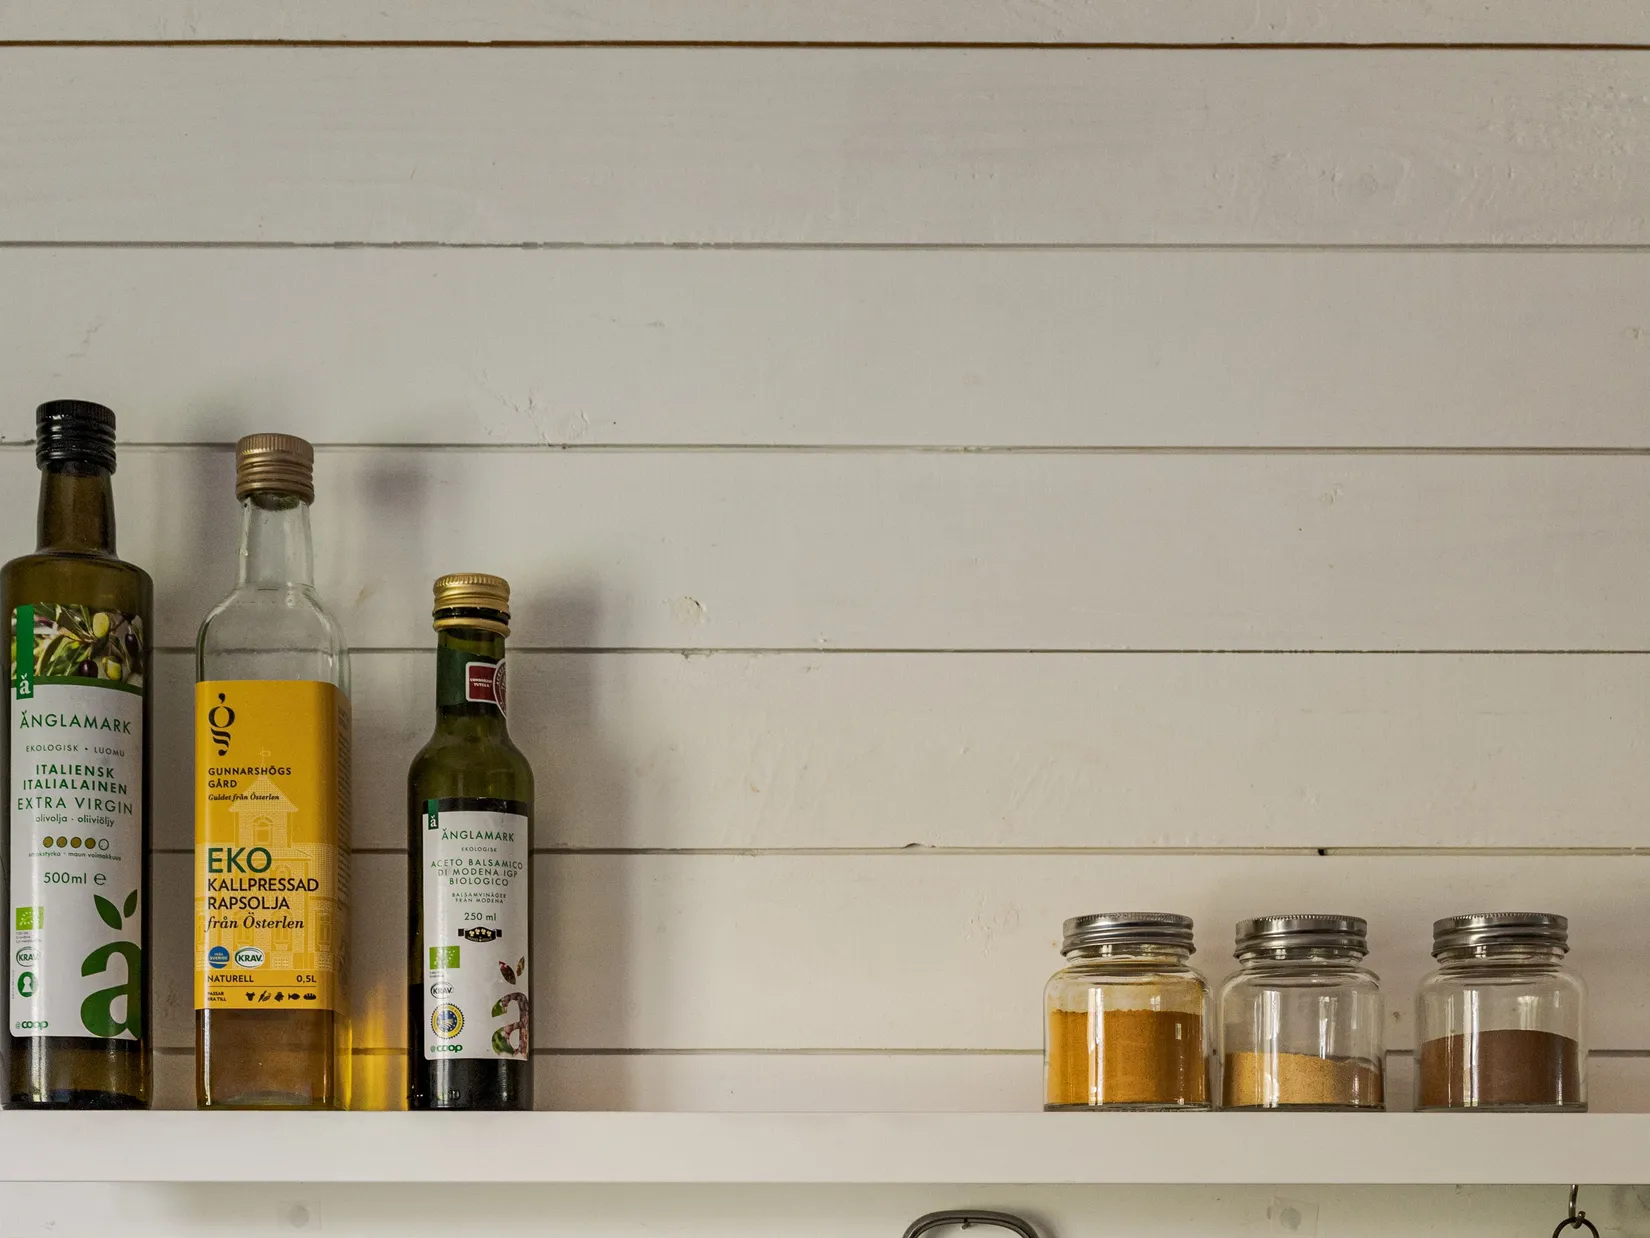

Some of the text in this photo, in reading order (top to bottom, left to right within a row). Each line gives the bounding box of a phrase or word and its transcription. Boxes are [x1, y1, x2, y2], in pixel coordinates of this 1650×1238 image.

[26, 744, 125, 757] EKOLOGISK LUOMU
[36, 764, 115, 779] ITALIENSK
[208, 765, 292, 776] GUNNARSHÖGS
[23, 779, 127, 795] ITALIALAINEN
[208, 778, 238, 788] GÅRD
[208, 792, 280, 803] Guldet från Österlen
[18, 797, 133, 815] EXTRA VIRGIN
[35, 813, 115, 828] olivolja oliiviöljy
[208, 847, 272, 873] EKO
[431, 858, 523, 870] ACETO BALSAMICO
[438, 868, 518, 878] DI MODENA IGP
[208, 878, 319, 892] KALLPRESSAD
[449, 877, 509, 886] BIOLOGICO
[208, 896, 290, 910] RAPSOLJA
[204, 912, 304, 933] från Österlen
[464, 912, 497, 921] 250 ml
[208, 974, 317, 983] NATURELL 0,5L
